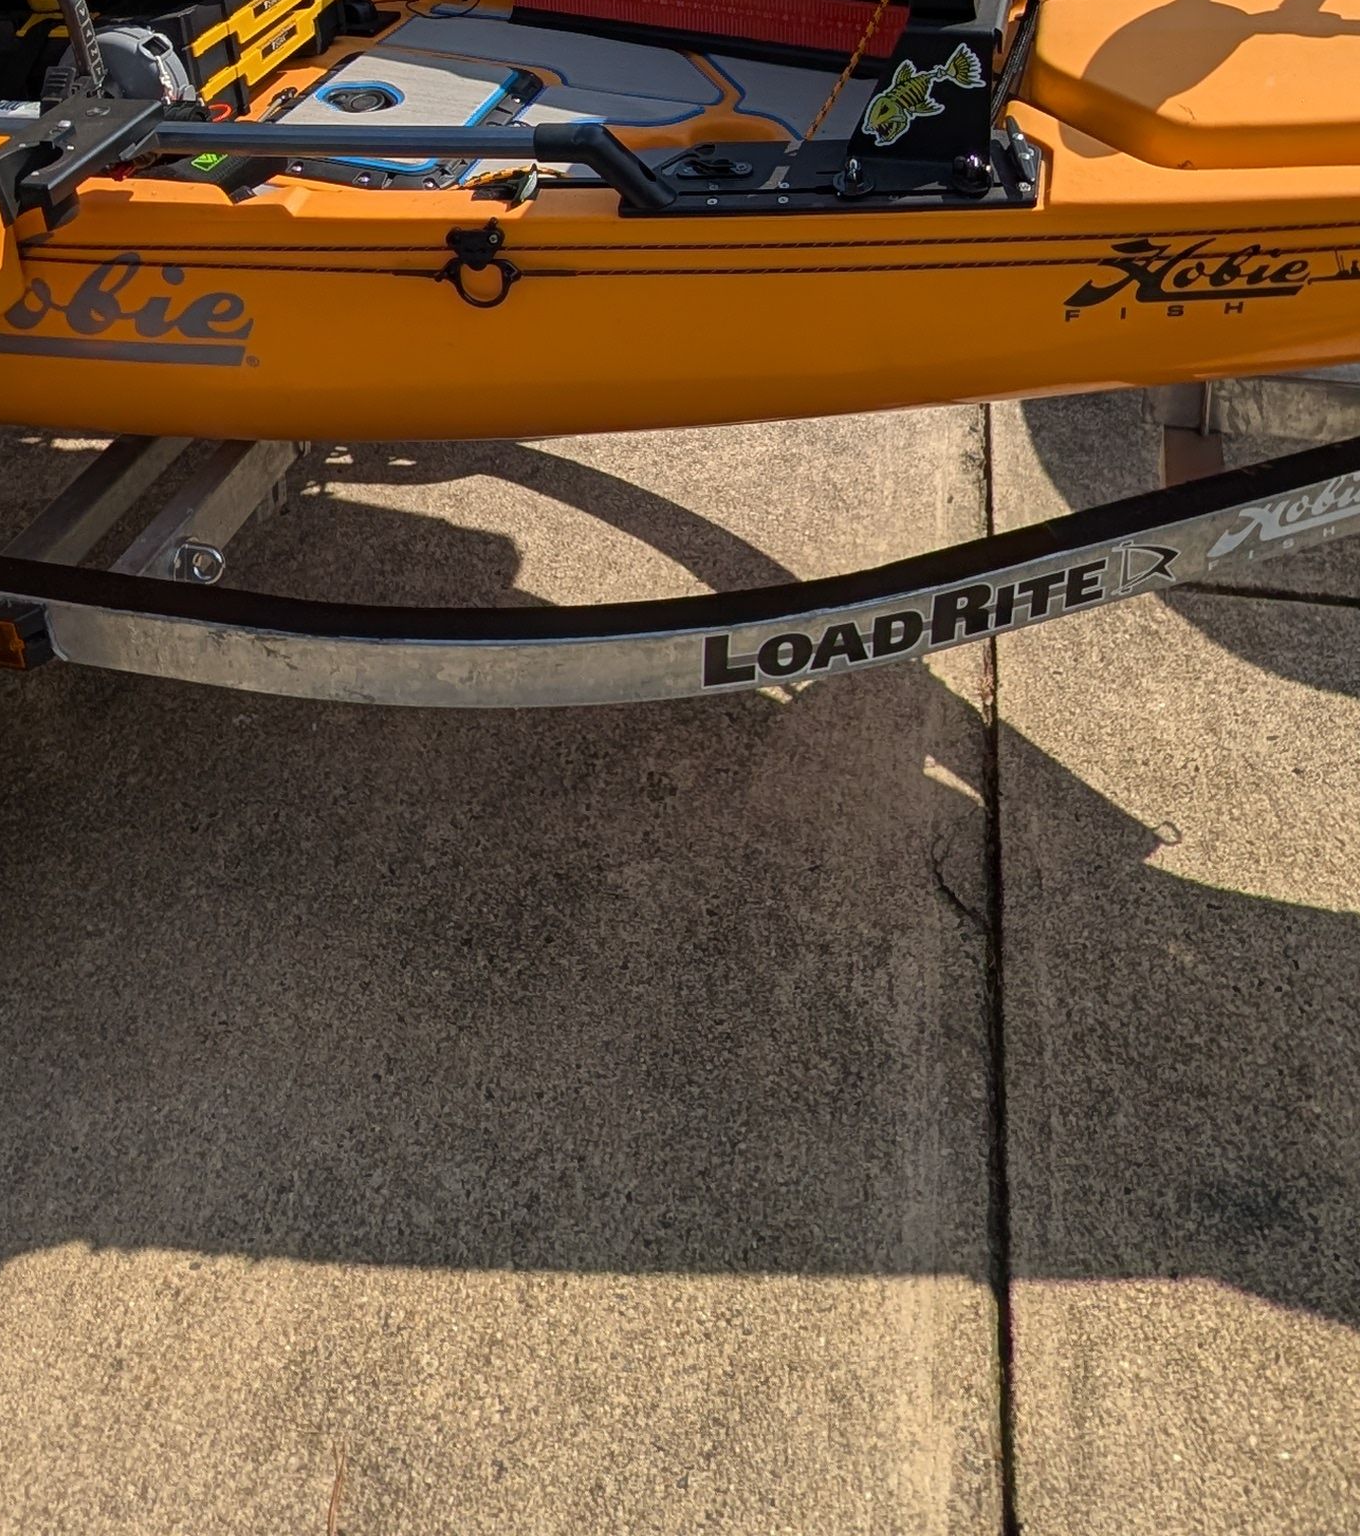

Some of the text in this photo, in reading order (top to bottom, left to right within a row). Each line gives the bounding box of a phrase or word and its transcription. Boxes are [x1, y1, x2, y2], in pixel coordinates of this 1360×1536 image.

[3, 251, 255, 343] obie
[1063, 238, 1311, 307] Hobie
[1064, 302, 1244, 323] FISH
